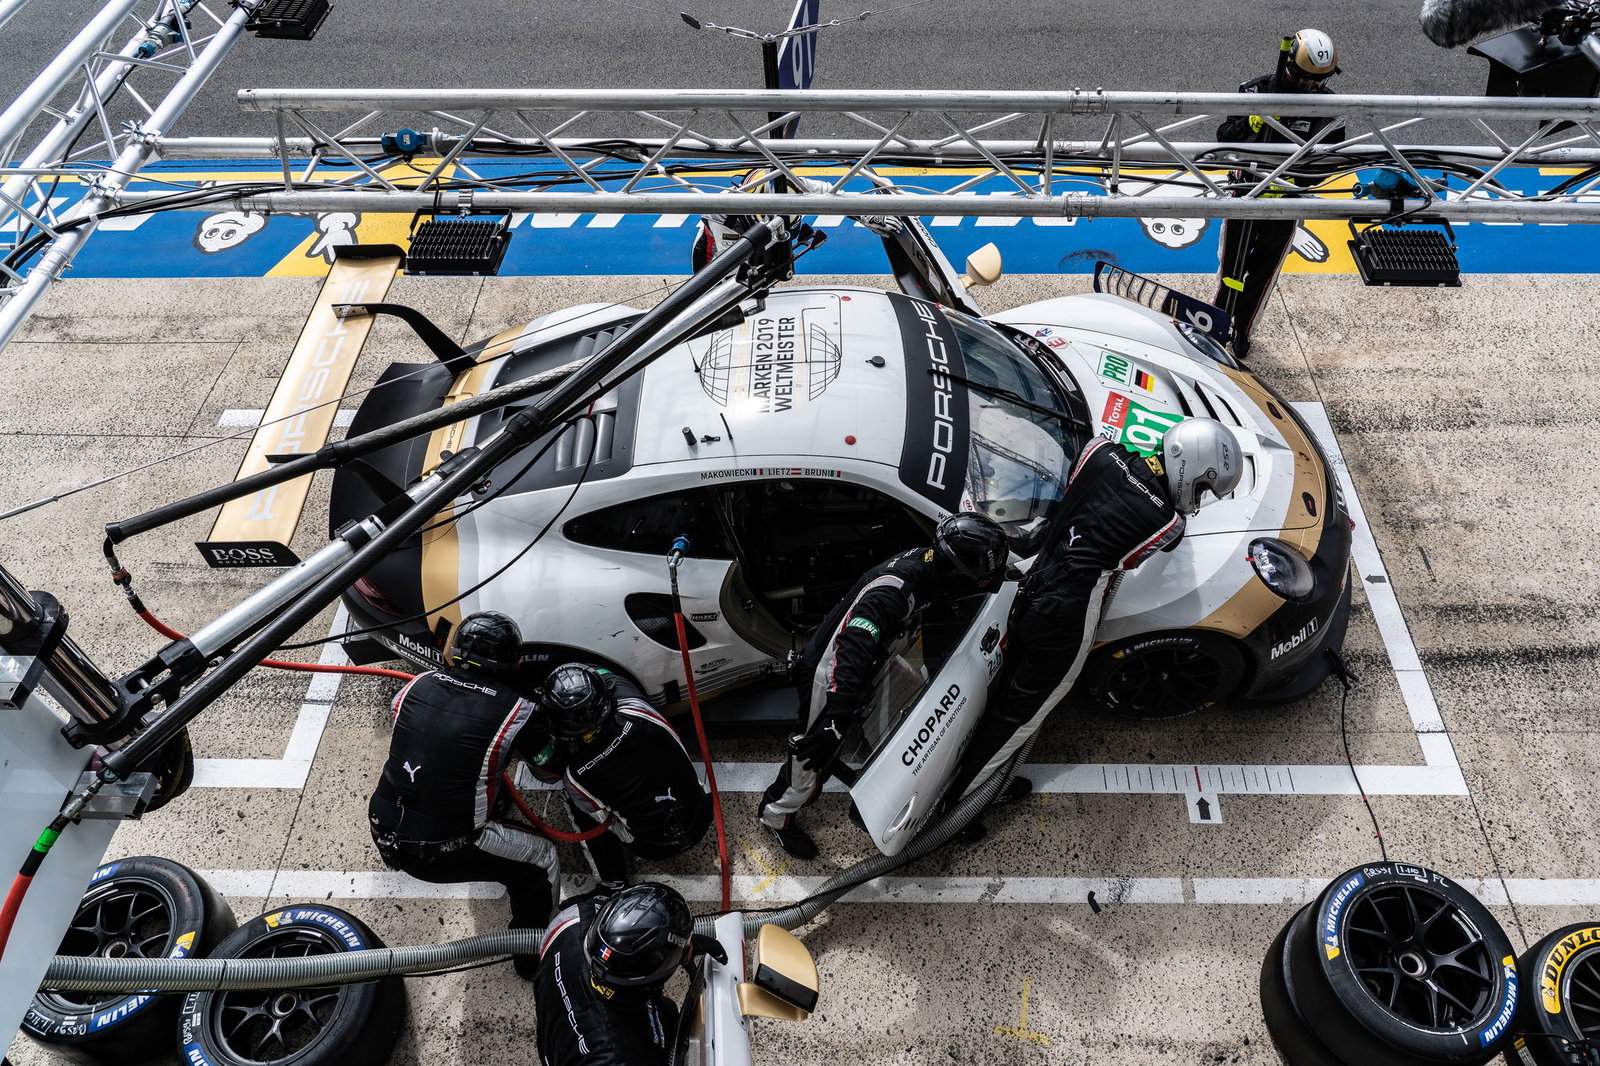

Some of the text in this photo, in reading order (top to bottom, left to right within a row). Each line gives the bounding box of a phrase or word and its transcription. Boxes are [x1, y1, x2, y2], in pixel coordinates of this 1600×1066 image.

[1317, 50, 1329, 60] 91
[756, 318, 774, 350] 2019
[775, 317, 795, 413] WELTMEISTER
[1102, 354, 1129, 383] PRO
[911, 300, 953, 490] PORSCHE
[1108, 396, 1125, 424] TOTAL
[1126, 407, 1176, 452] 91
[701, 469, 753, 480] MAKOWIECKI
[768, 468, 790, 476] LIETZ
[1109, 452, 1164, 508] PORSCHE
[210, 548, 275, 560] BOSS
[400, 633, 431, 658] Mobil
[1134, 637, 1193, 651] MICHELIN
[1270, 631, 1307, 660] Mobil
[432, 672, 498, 697] PORSCHE
[902, 683, 961, 767] CHOPARD
[912, 762, 923, 777] THE
[921, 735, 942, 764] ARTISAN
[946, 696, 968, 729] EMOTIONS
[577, 721, 633, 775] PORSCHE
[1327, 878, 1360, 933] MICHELIN
[296, 910, 360, 948] MICHELIN
[554, 951, 590, 1055] PORSCHE
[1484, 981, 1517, 1042] MICHELIN
